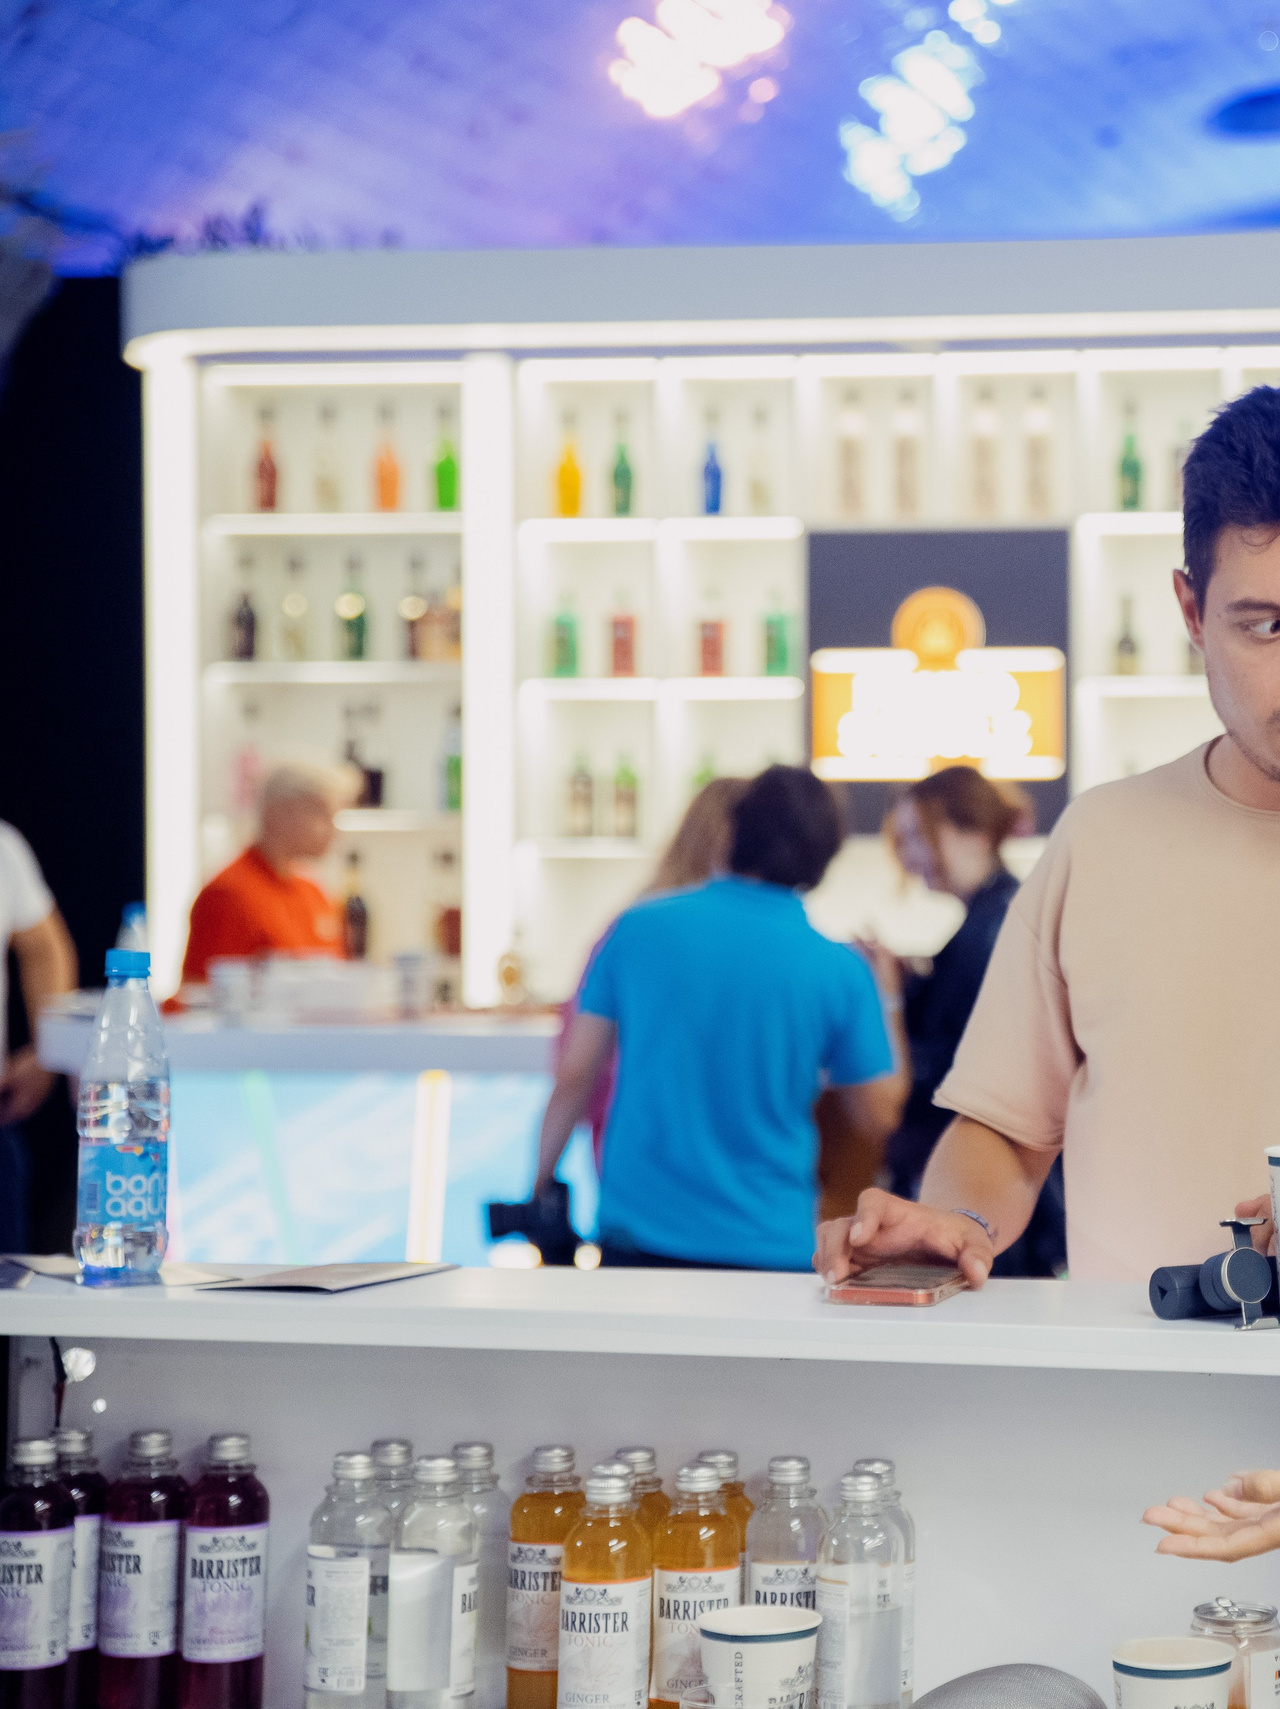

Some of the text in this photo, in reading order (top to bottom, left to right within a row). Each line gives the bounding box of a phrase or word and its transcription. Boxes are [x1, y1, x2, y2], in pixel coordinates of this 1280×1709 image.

[106, 1196, 167, 1221] aqu
[190, 1556, 261, 1579] BARRISTER
[200, 1579, 251, 1594] TONIC
[668, 1621, 701, 1634] TON
[567, 1634, 613, 1648] TONIC
[666, 1679, 704, 1689] GINGE
[565, 1692, 609, 1704] GINGER
